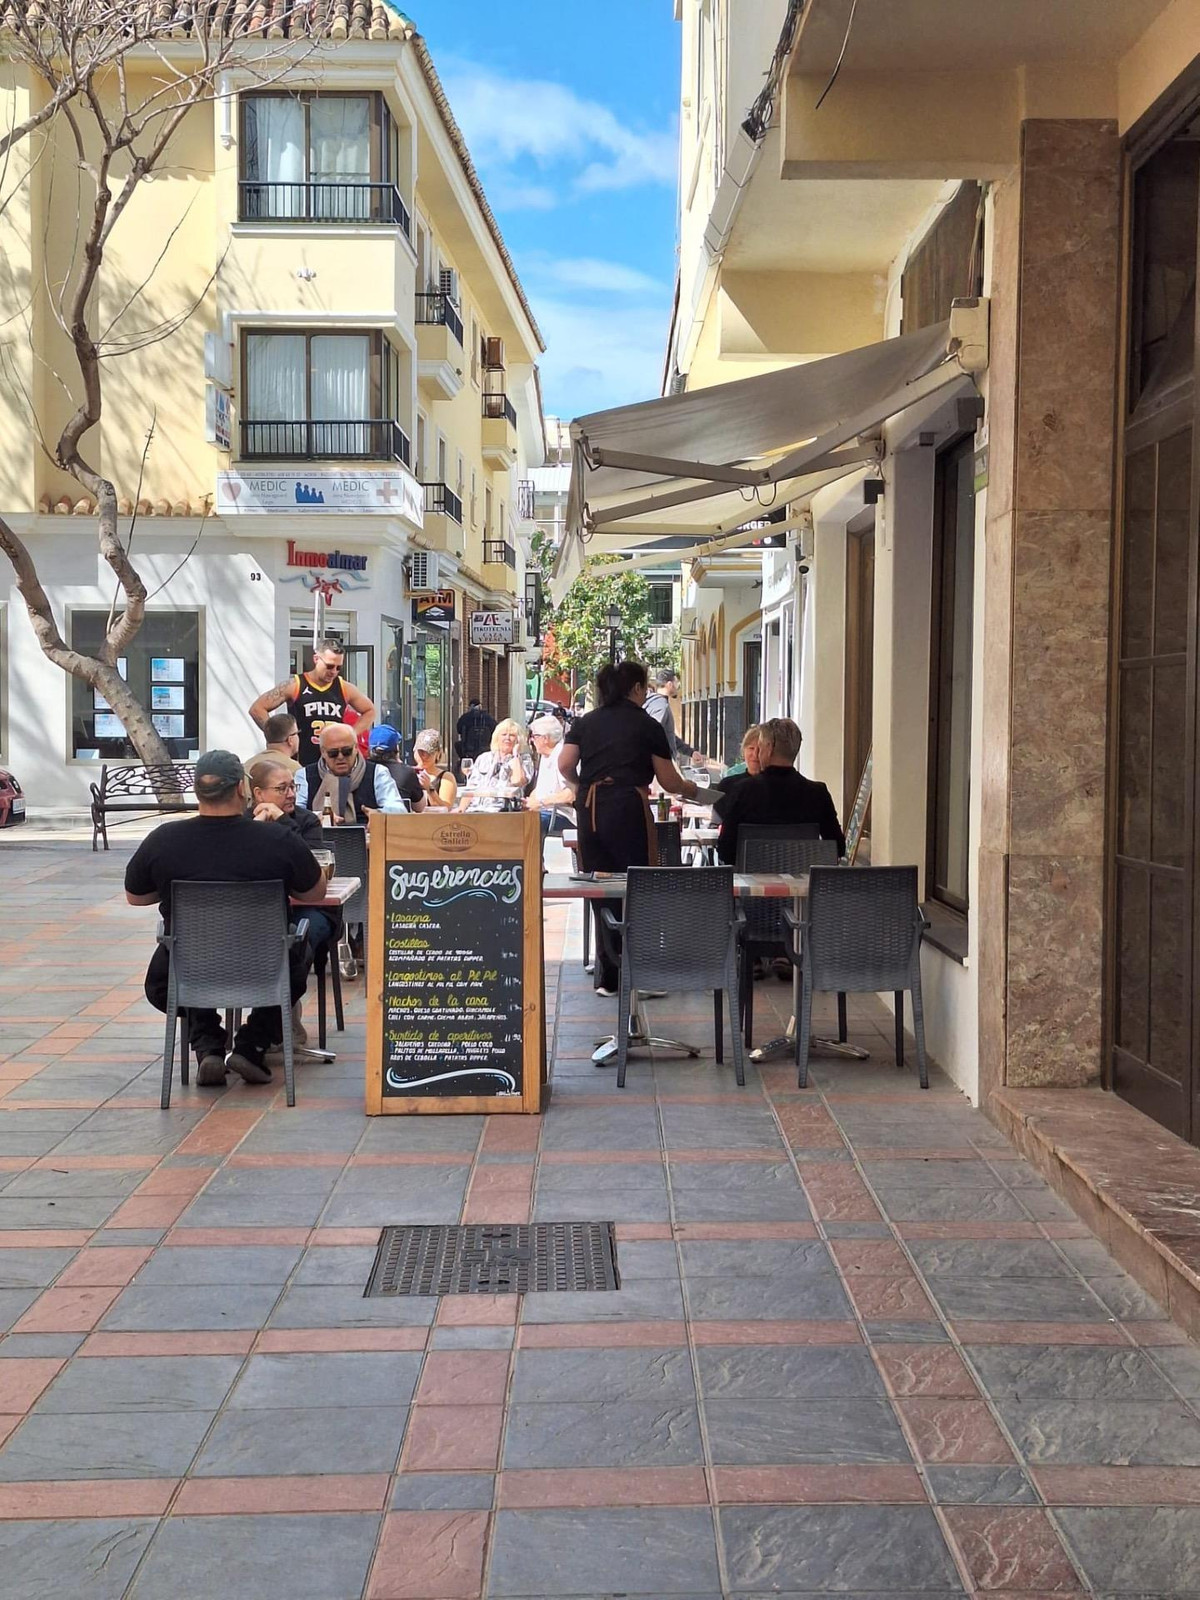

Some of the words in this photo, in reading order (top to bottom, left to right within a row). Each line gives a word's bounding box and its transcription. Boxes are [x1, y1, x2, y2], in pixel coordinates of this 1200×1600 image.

[249, 481, 287, 492] MEDIC
[332, 481, 369, 492] MEDIC
[736, 520, 772, 531] RGER
[287, 540, 367, 571] Inmoalmar
[250, 573, 261, 581] 93
[420, 592, 452, 604] ATM
[303, 701, 342, 718] PHX
[440, 830, 471, 838] Estrella
[441, 838, 470, 846] Galicia
[389, 864, 523, 904] Sugerencias
[391, 912, 432, 924] Lasagna
[388, 938, 431, 949] Costillas
[388, 970, 445, 982] Langostinos
[450, 971, 463, 982] al
[389, 996, 423, 1007] Nachos
[428, 996, 440, 1007] de
[447, 994, 460, 1007] la
[465, 997, 490, 1007] casa
[389, 1029, 423, 1041] Surtido
[428, 1030, 440, 1041] de
[447, 1030, 493, 1044] aperitivos
